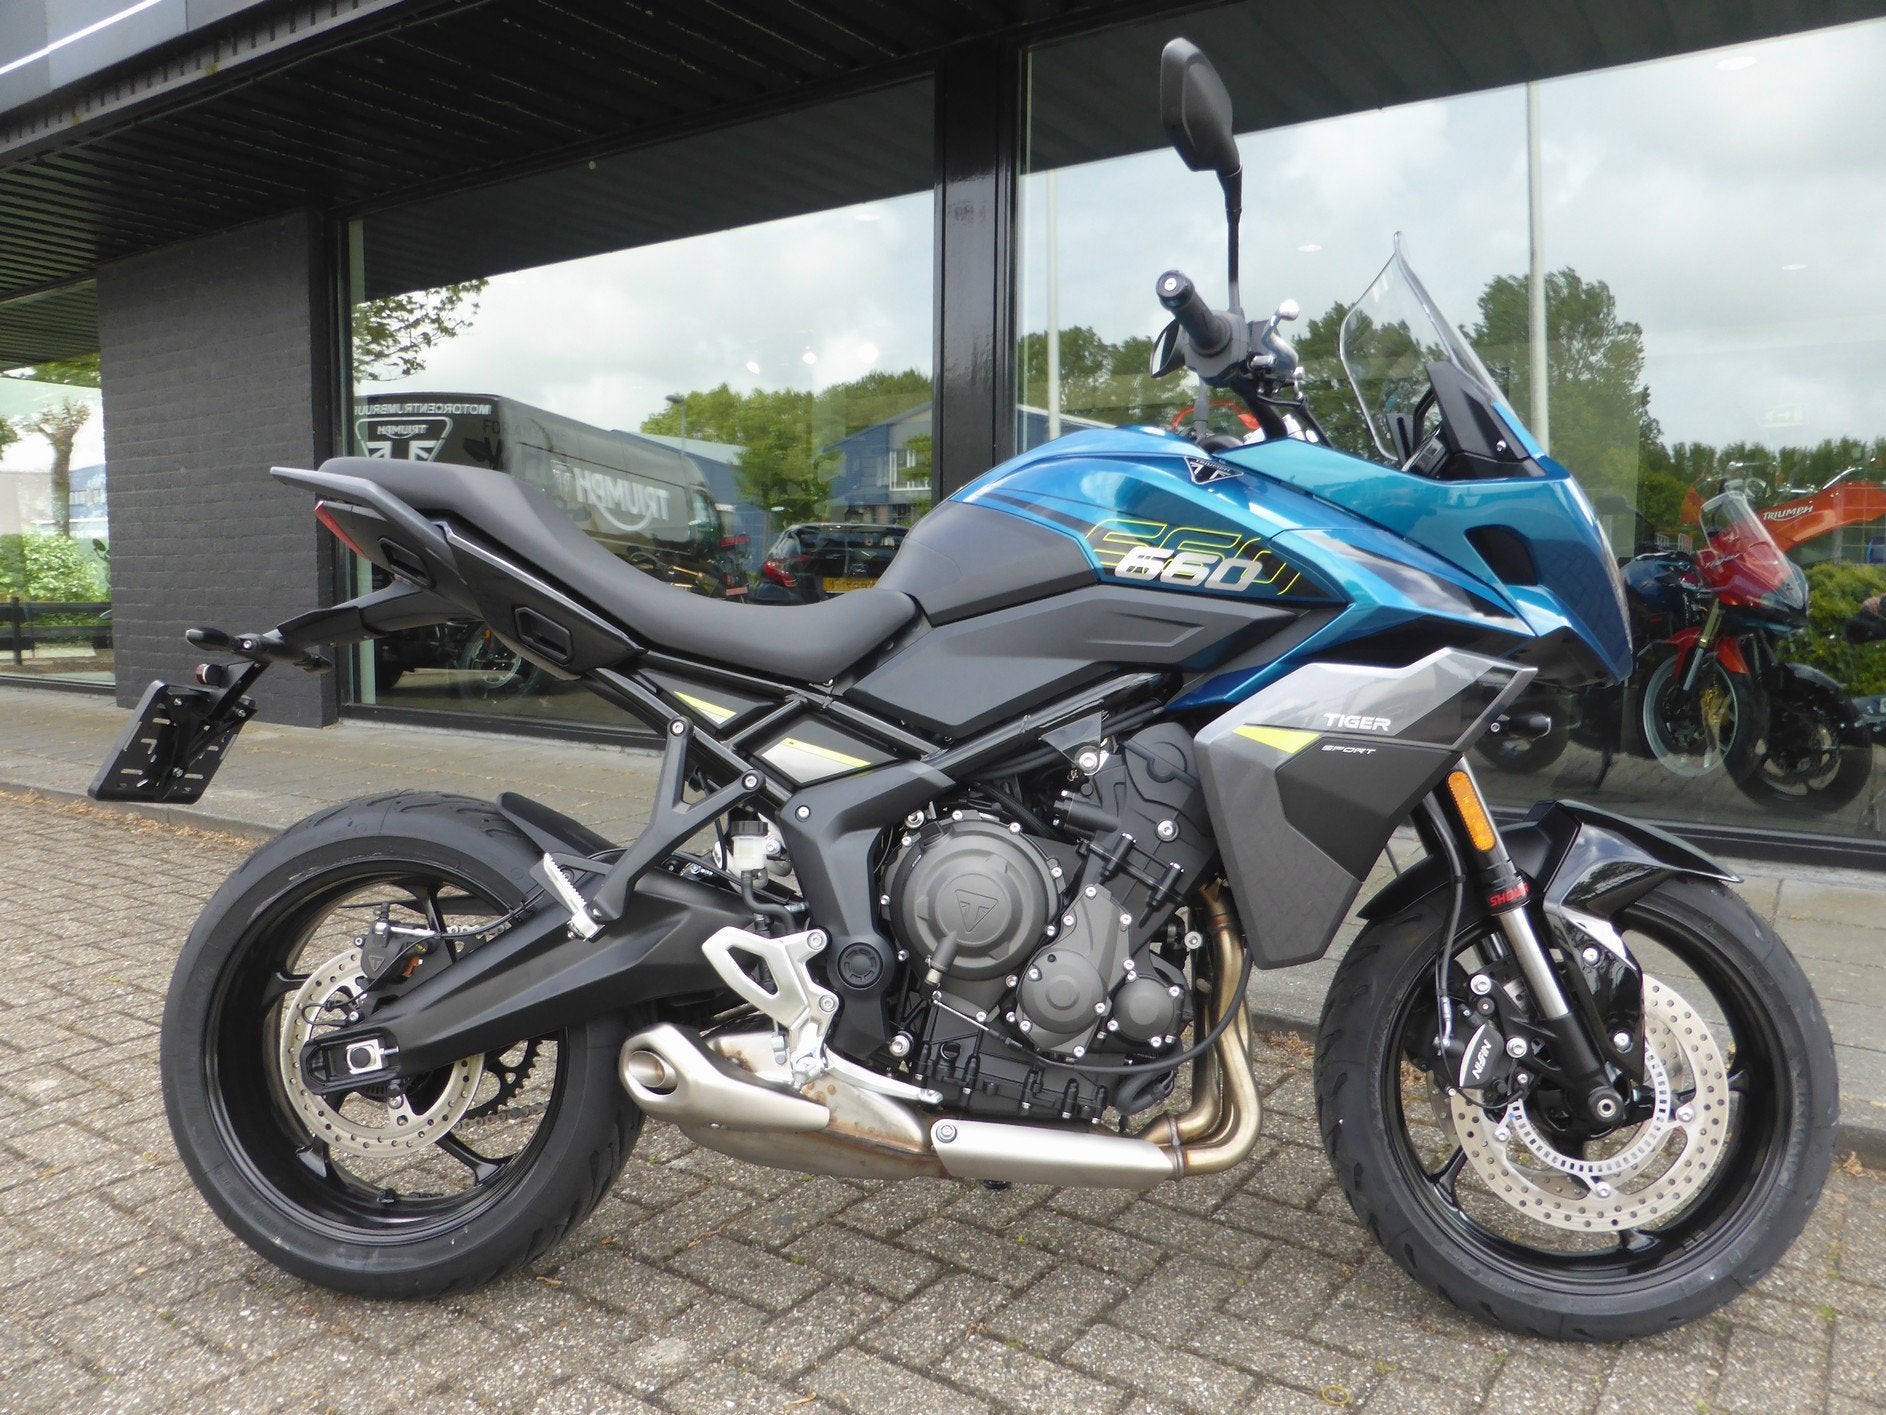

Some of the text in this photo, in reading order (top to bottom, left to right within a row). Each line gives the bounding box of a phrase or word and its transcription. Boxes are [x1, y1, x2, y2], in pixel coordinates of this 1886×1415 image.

[1763, 506, 1814, 521] TRIUMPH
[1114, 546, 1263, 592] 660
[1323, 712, 1392, 732] TIGER
[1321, 745, 1377, 755] SPORT
